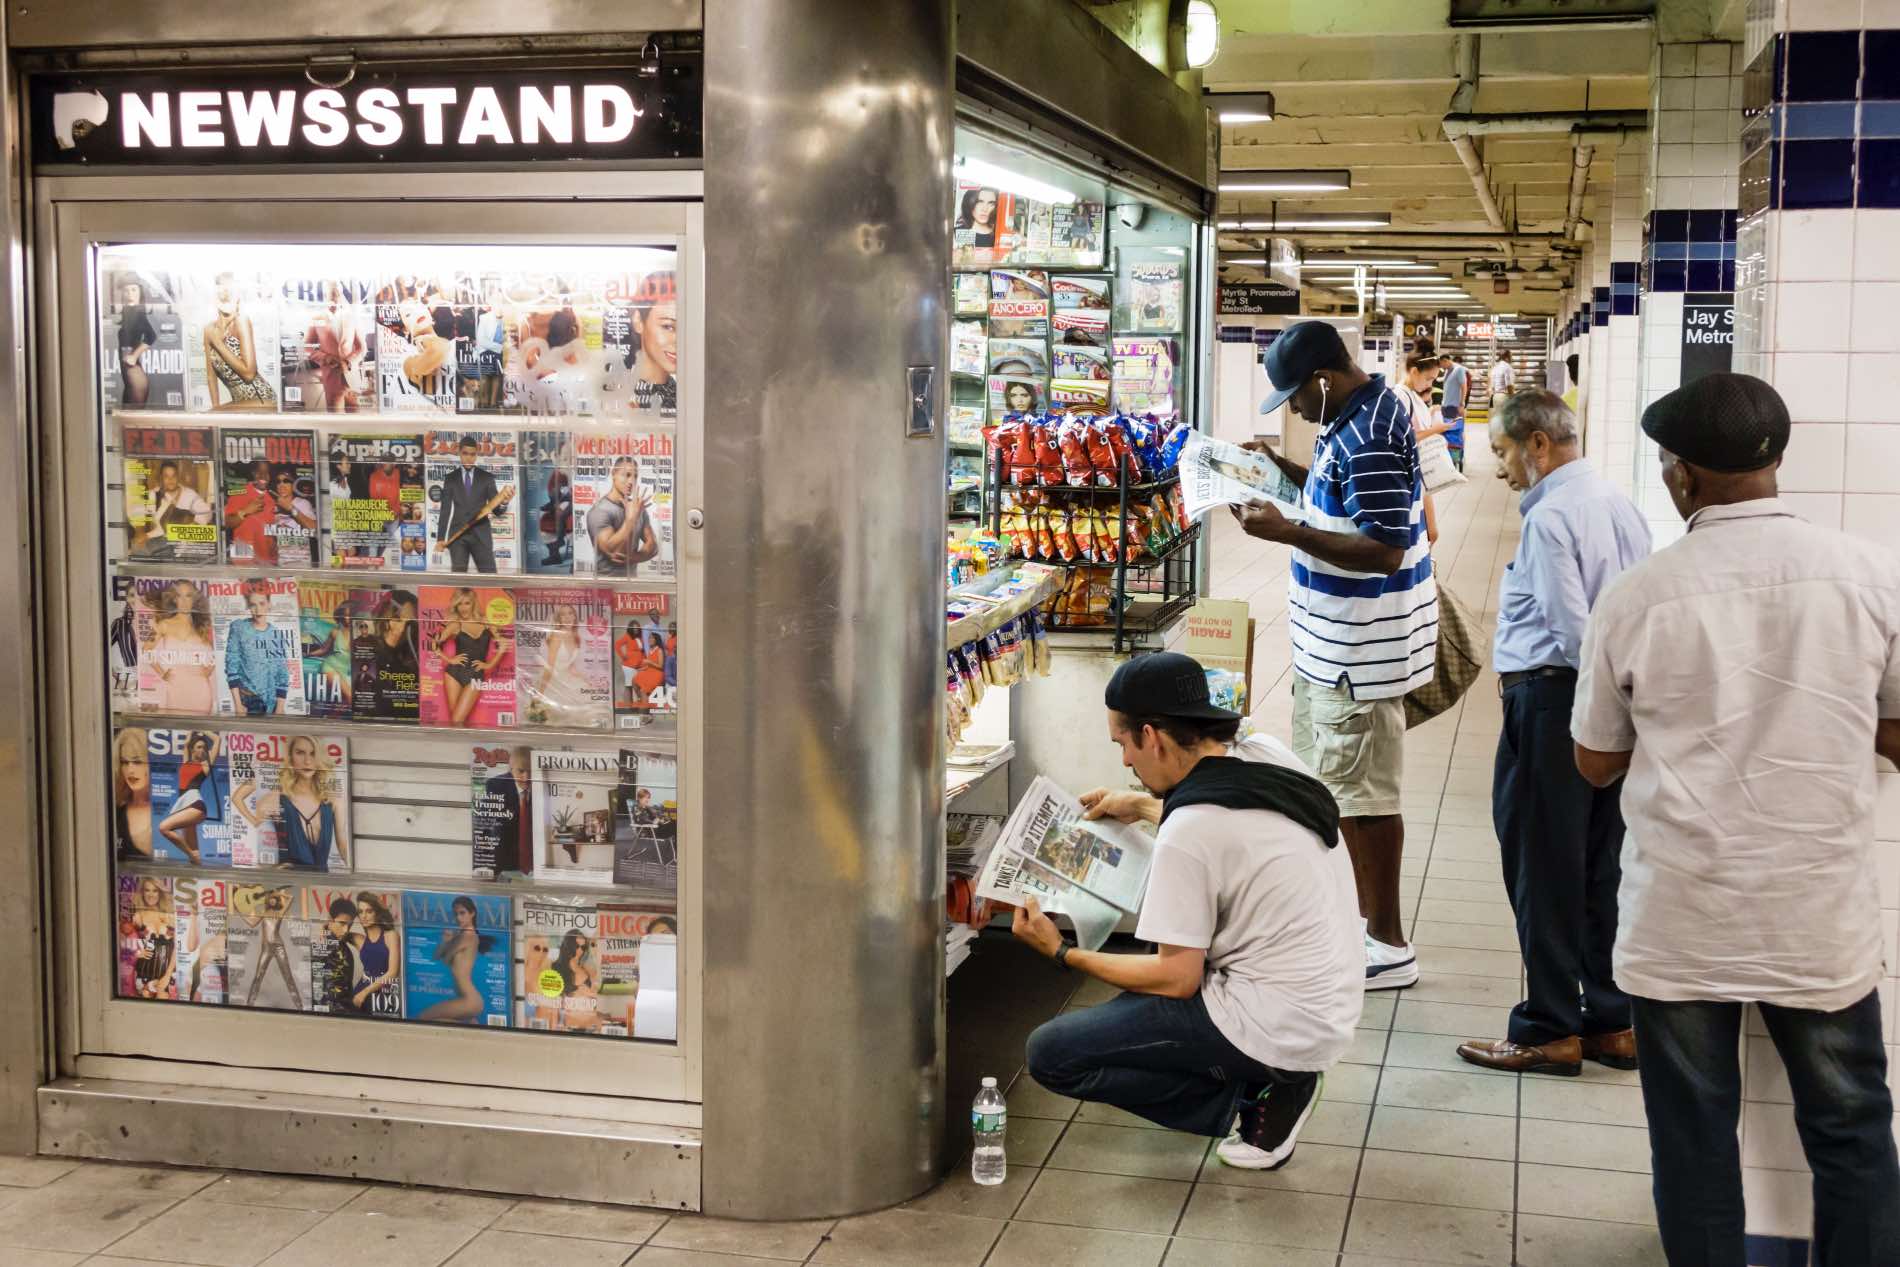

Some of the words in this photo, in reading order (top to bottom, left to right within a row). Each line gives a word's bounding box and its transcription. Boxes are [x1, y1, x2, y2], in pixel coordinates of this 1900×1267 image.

[121, 84, 643, 148] NEWSSTAND
[1221, 288, 1247, 298] Myrtle
[1249, 288, 1297, 297] Promenade
[1221, 297, 1236, 306] Jay
[1239, 297, 1249, 305] St
[1221, 305, 1263, 313] MetroTech
[1687, 309, 1719, 328] Jay
[1723, 309, 1735, 325] S
[1467, 323, 1493, 336] Exit
[1685, 328, 1735, 344] Metro
[140, 349, 185, 374] HADID
[170, 526, 214, 534] CHRISTIAN
[264, 524, 315, 536] Murder
[177, 533, 215, 541] CLAUDIO
[616, 594, 665, 612] Journal
[516, 631, 547, 640] DREAM
[255, 640, 295, 650] DENIM
[265, 650, 298, 660] ISSUE
[379, 670, 415, 681] Sheree
[470, 678, 516, 692] Naked!
[229, 733, 255, 753] COS
[233, 753, 253, 762] BEST
[232, 769, 256, 779] EVER
[474, 801, 505, 811] Trump
[473, 809, 514, 820] Seriously
[1029, 794, 1059, 842] ATTEMPT
[993, 863, 1018, 890] TANKS
[525, 909, 597, 929] PENTHOU
